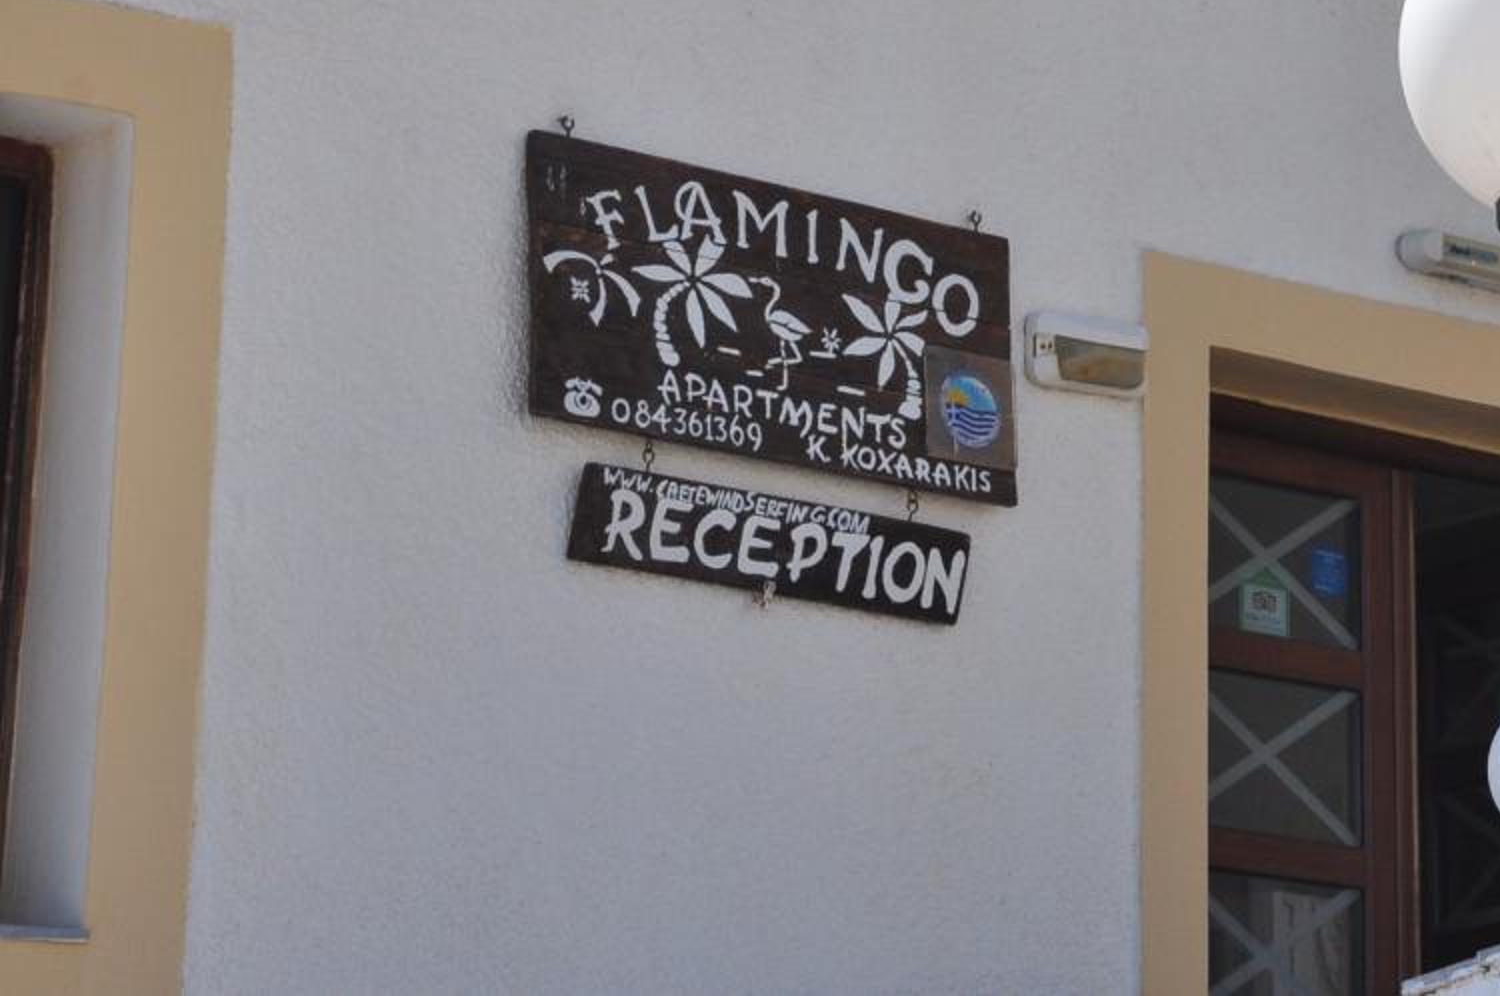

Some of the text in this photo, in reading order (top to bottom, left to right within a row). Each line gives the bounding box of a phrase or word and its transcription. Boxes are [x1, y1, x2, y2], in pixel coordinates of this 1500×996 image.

[586, 181, 979, 337] FLAMINGO
[611, 398, 763, 452] 084361369
[657, 369, 907, 449] APARTMENTS
[840, 442, 992, 493] KOXARAKIS
[601, 489, 966, 615] RECEPTION
